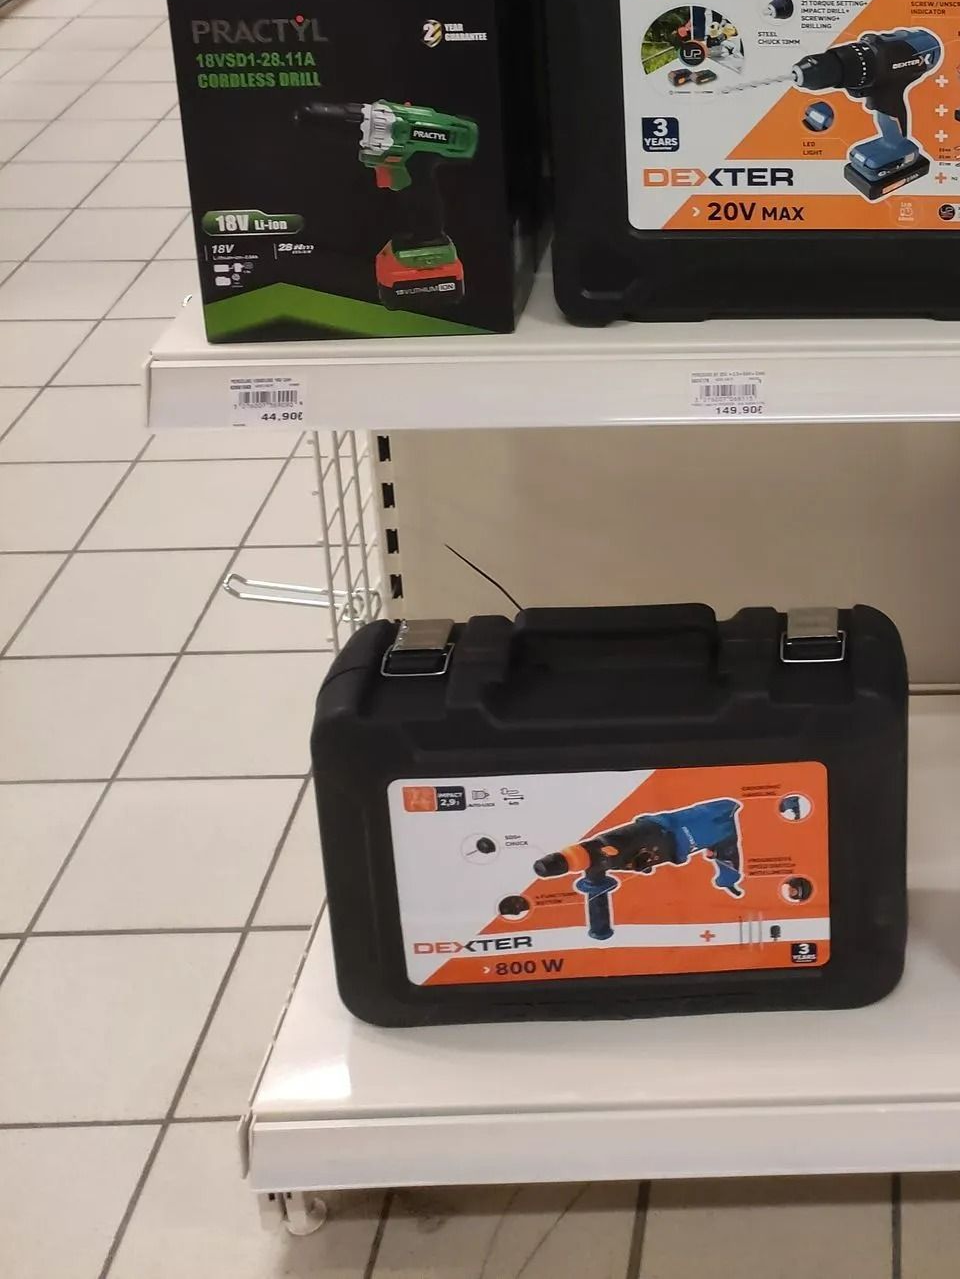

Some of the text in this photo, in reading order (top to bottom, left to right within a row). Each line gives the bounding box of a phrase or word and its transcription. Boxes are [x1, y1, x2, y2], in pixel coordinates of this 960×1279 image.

[191, 15, 329, 44] PRACTYL
[423, 23, 437, 42] 2
[444, 23, 464, 31] YEAR
[444, 33, 488, 41] GUARANTEE
[196, 51, 316, 68] 18VSD1-28.11A
[197, 72, 321, 88] CORDLESS DRILL
[412, 129, 448, 141] PRACTYL
[652, 118, 668, 137] 3
[644, 138, 678, 146] YEARS
[643, 168, 794, 187] DEXTER
[707, 201, 805, 221] 20V MAX
[215, 214, 288, 232] 18V Li-ion
[211, 244, 235, 254] 18V
[413, 935, 533, 954] DEXTER
[799, 943, 810, 955] 3
[496, 958, 564, 976] 800 W
